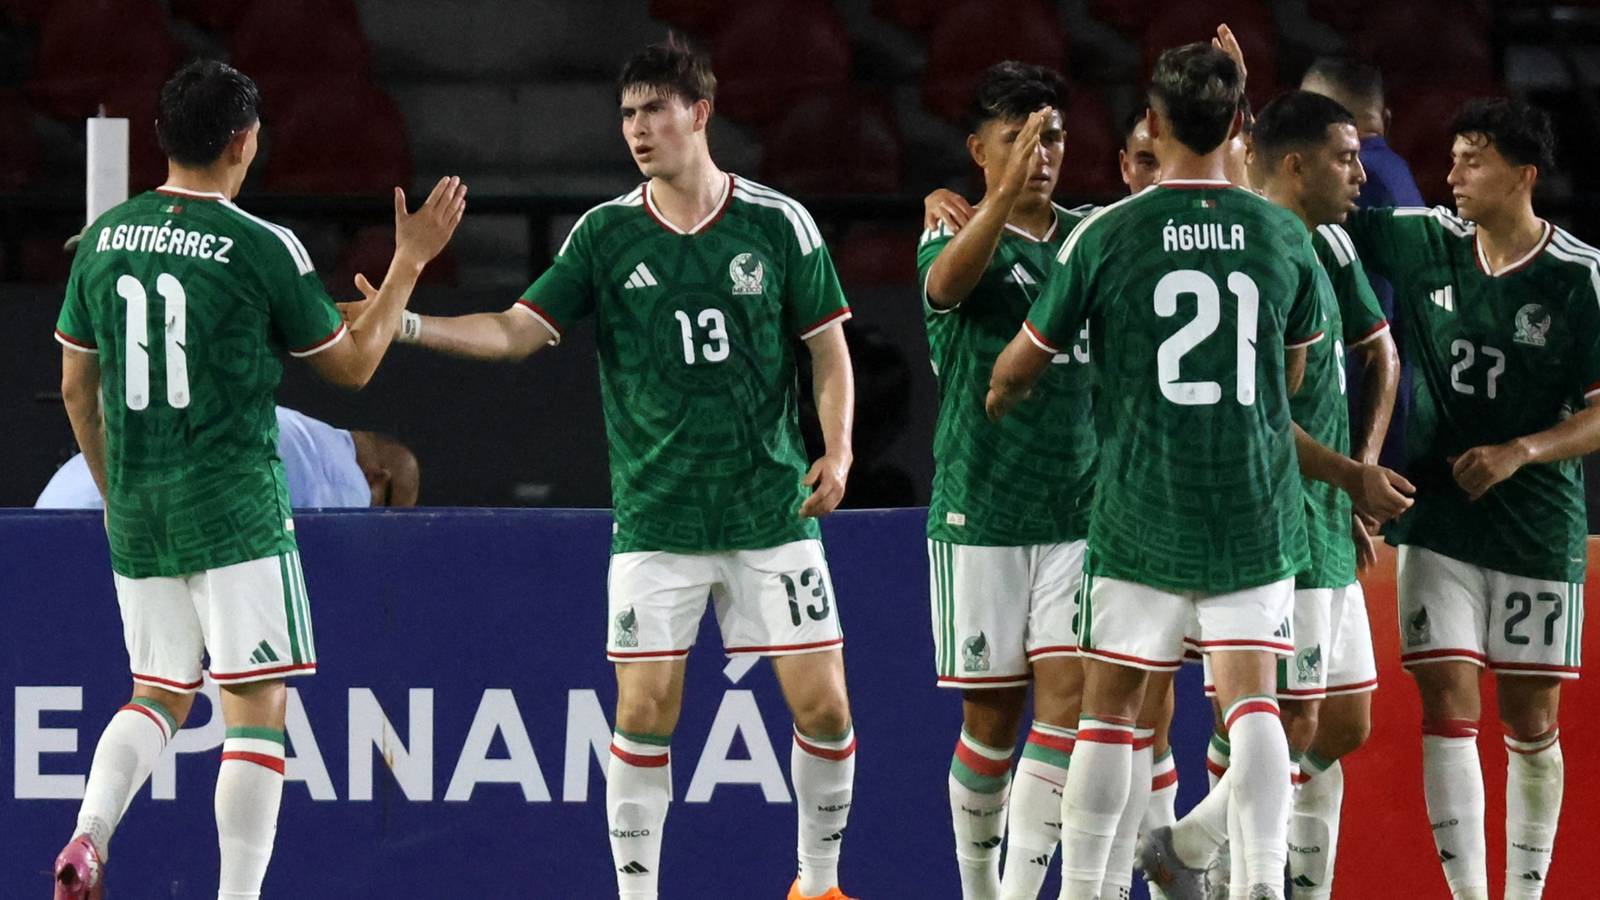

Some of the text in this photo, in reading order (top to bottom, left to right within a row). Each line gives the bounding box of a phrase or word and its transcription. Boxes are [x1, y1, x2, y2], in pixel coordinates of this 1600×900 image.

[96, 219, 234, 264] A.GUTIÉRREZ
[1162, 218, 1245, 252] ÁGUILA
[116, 272, 191, 411] 11
[674, 307, 730, 365] 13
[1153, 269, 1260, 406] 21
[1450, 338, 1506, 400] 27
[780, 567, 830, 628] 13
[1503, 587, 1563, 647] 27
[609, 828, 650, 838] ÉXICO
